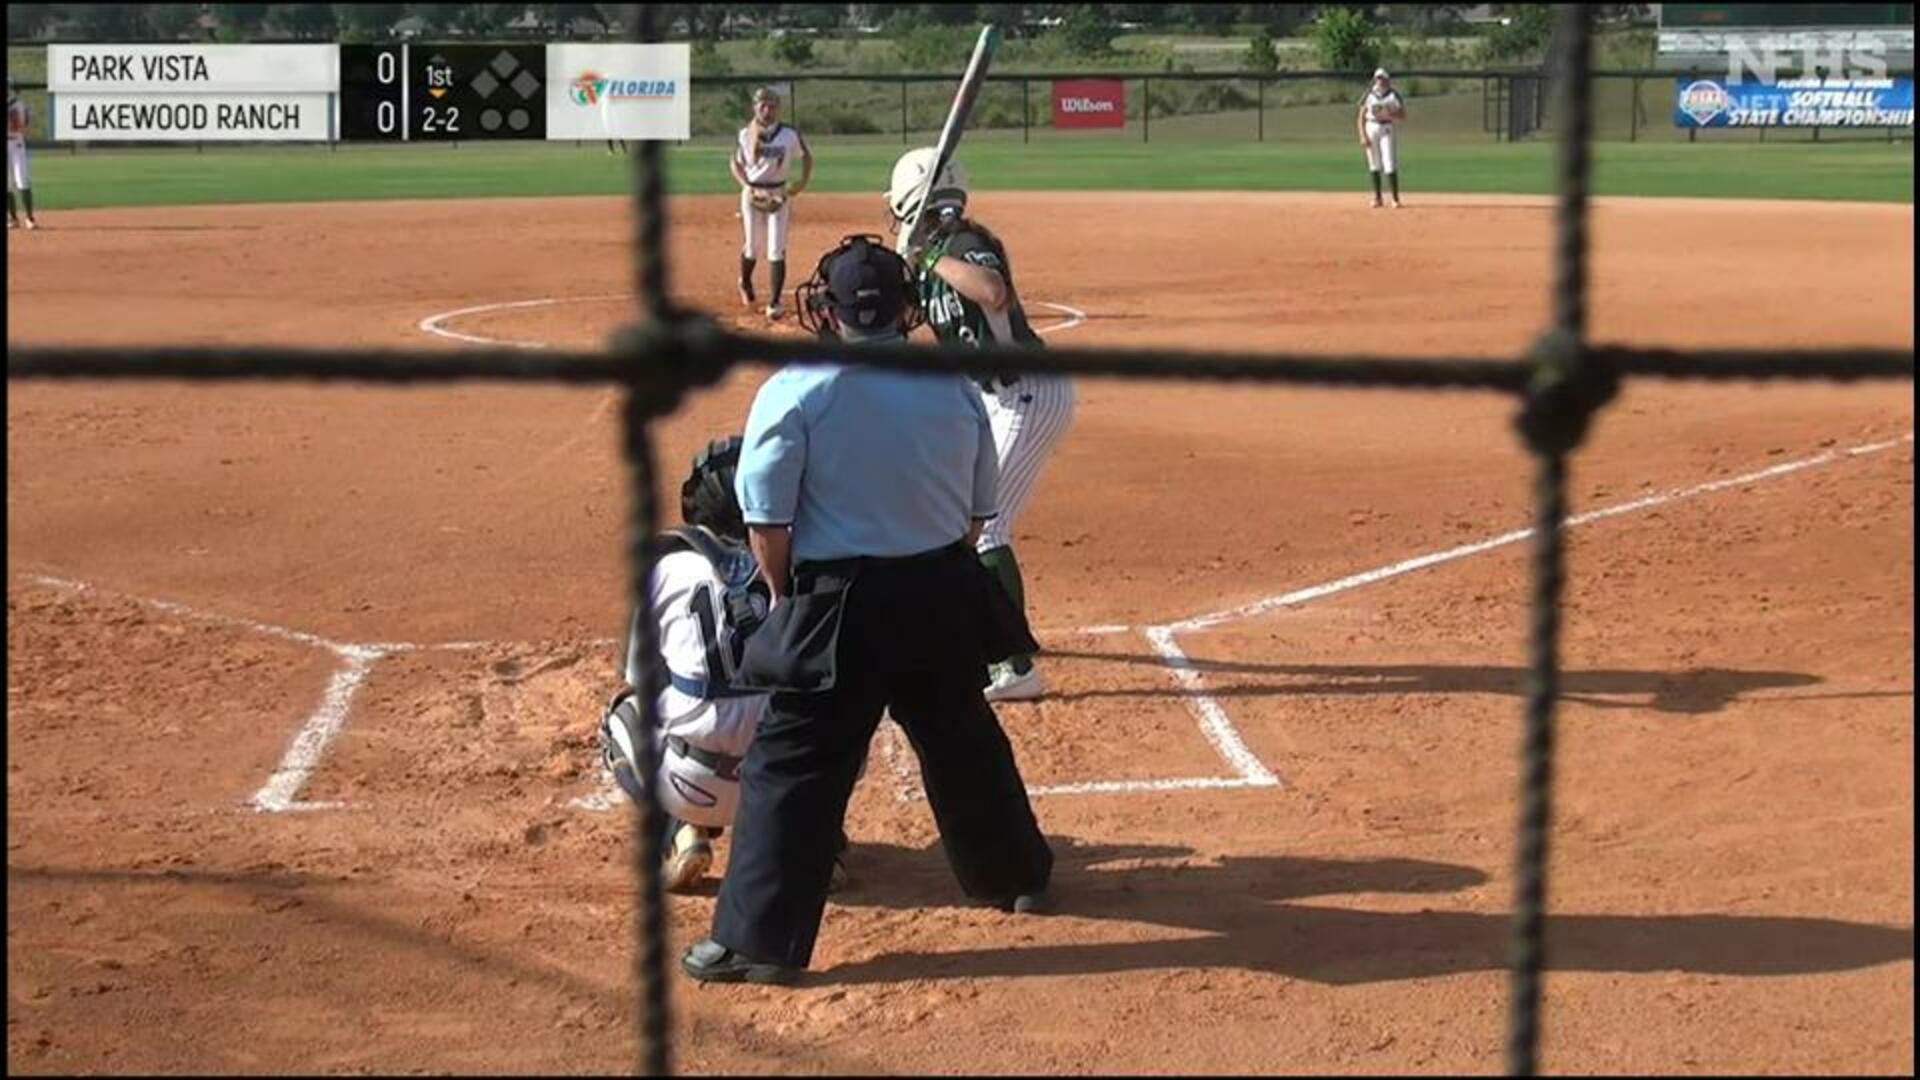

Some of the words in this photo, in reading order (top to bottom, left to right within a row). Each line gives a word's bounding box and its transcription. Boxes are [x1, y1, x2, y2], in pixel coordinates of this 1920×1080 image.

[1062, 98, 1114, 113] Wilson
[1791, 91, 1874, 107] SOFTBALL
[1728, 109, 1778, 125] STATE
